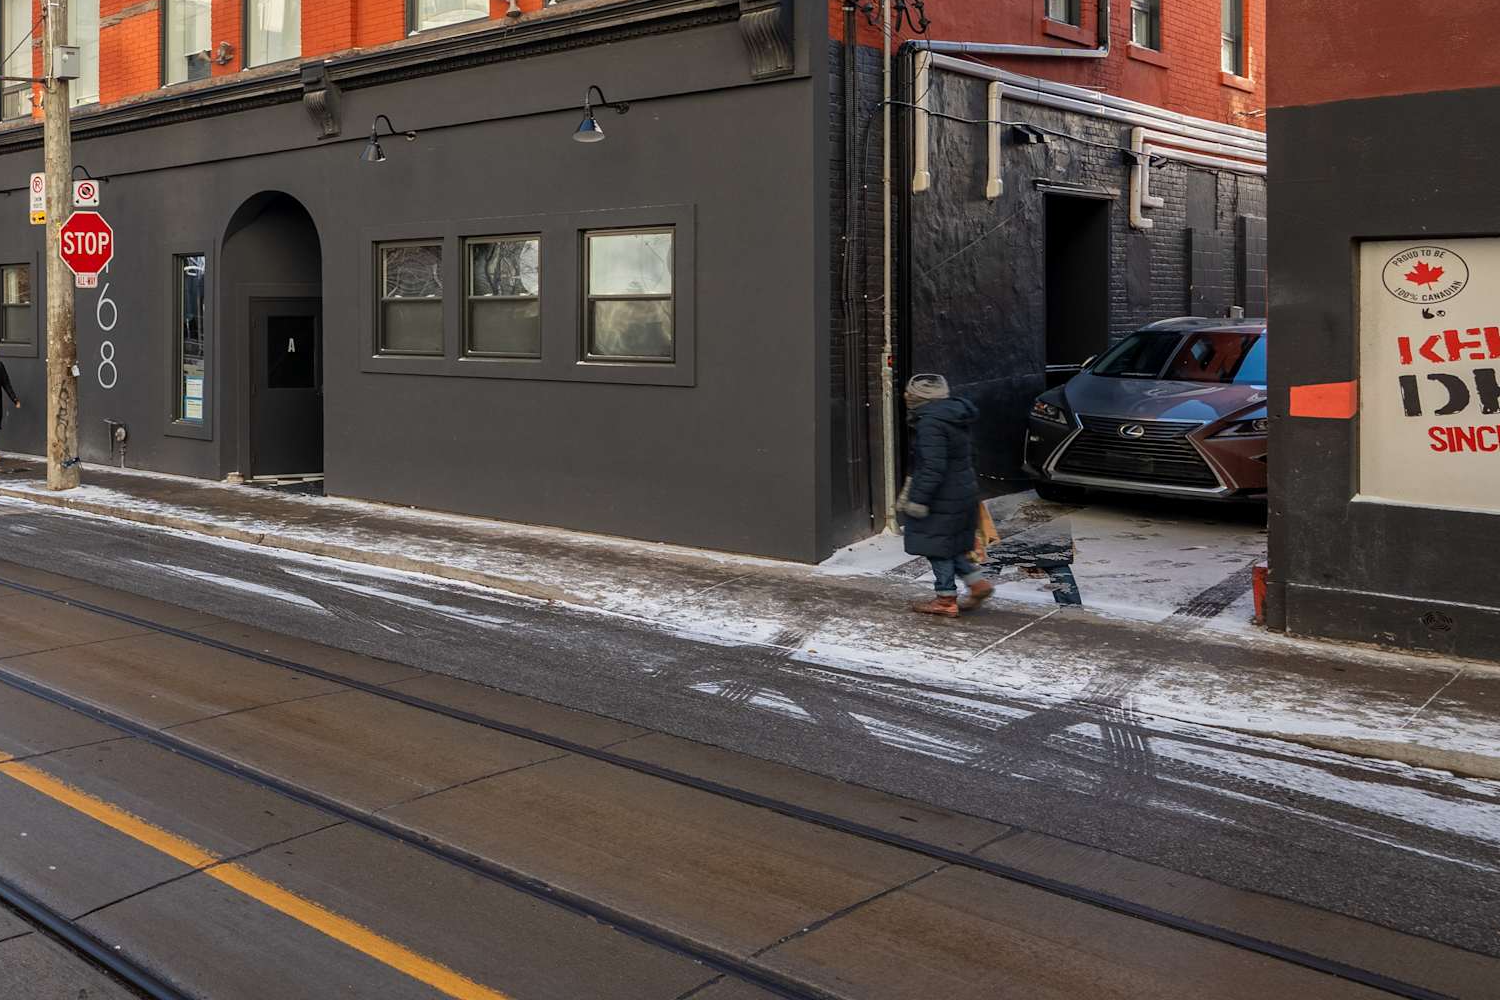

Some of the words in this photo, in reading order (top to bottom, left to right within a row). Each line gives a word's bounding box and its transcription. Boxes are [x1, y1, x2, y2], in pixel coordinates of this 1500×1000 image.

[63, 231, 110, 255] STOP
[1392, 250, 1419, 267] PROUD
[1420, 249, 1432, 257] TO
[1433, 251, 1446, 259] BE
[1394, 287, 1419, 301] 100%
[1422, 280, 1463, 302] CANADIAN
[97, 263, 118, 389] 68
[287, 337, 296, 353] A
[1428, 424, 1500, 453] SINC
